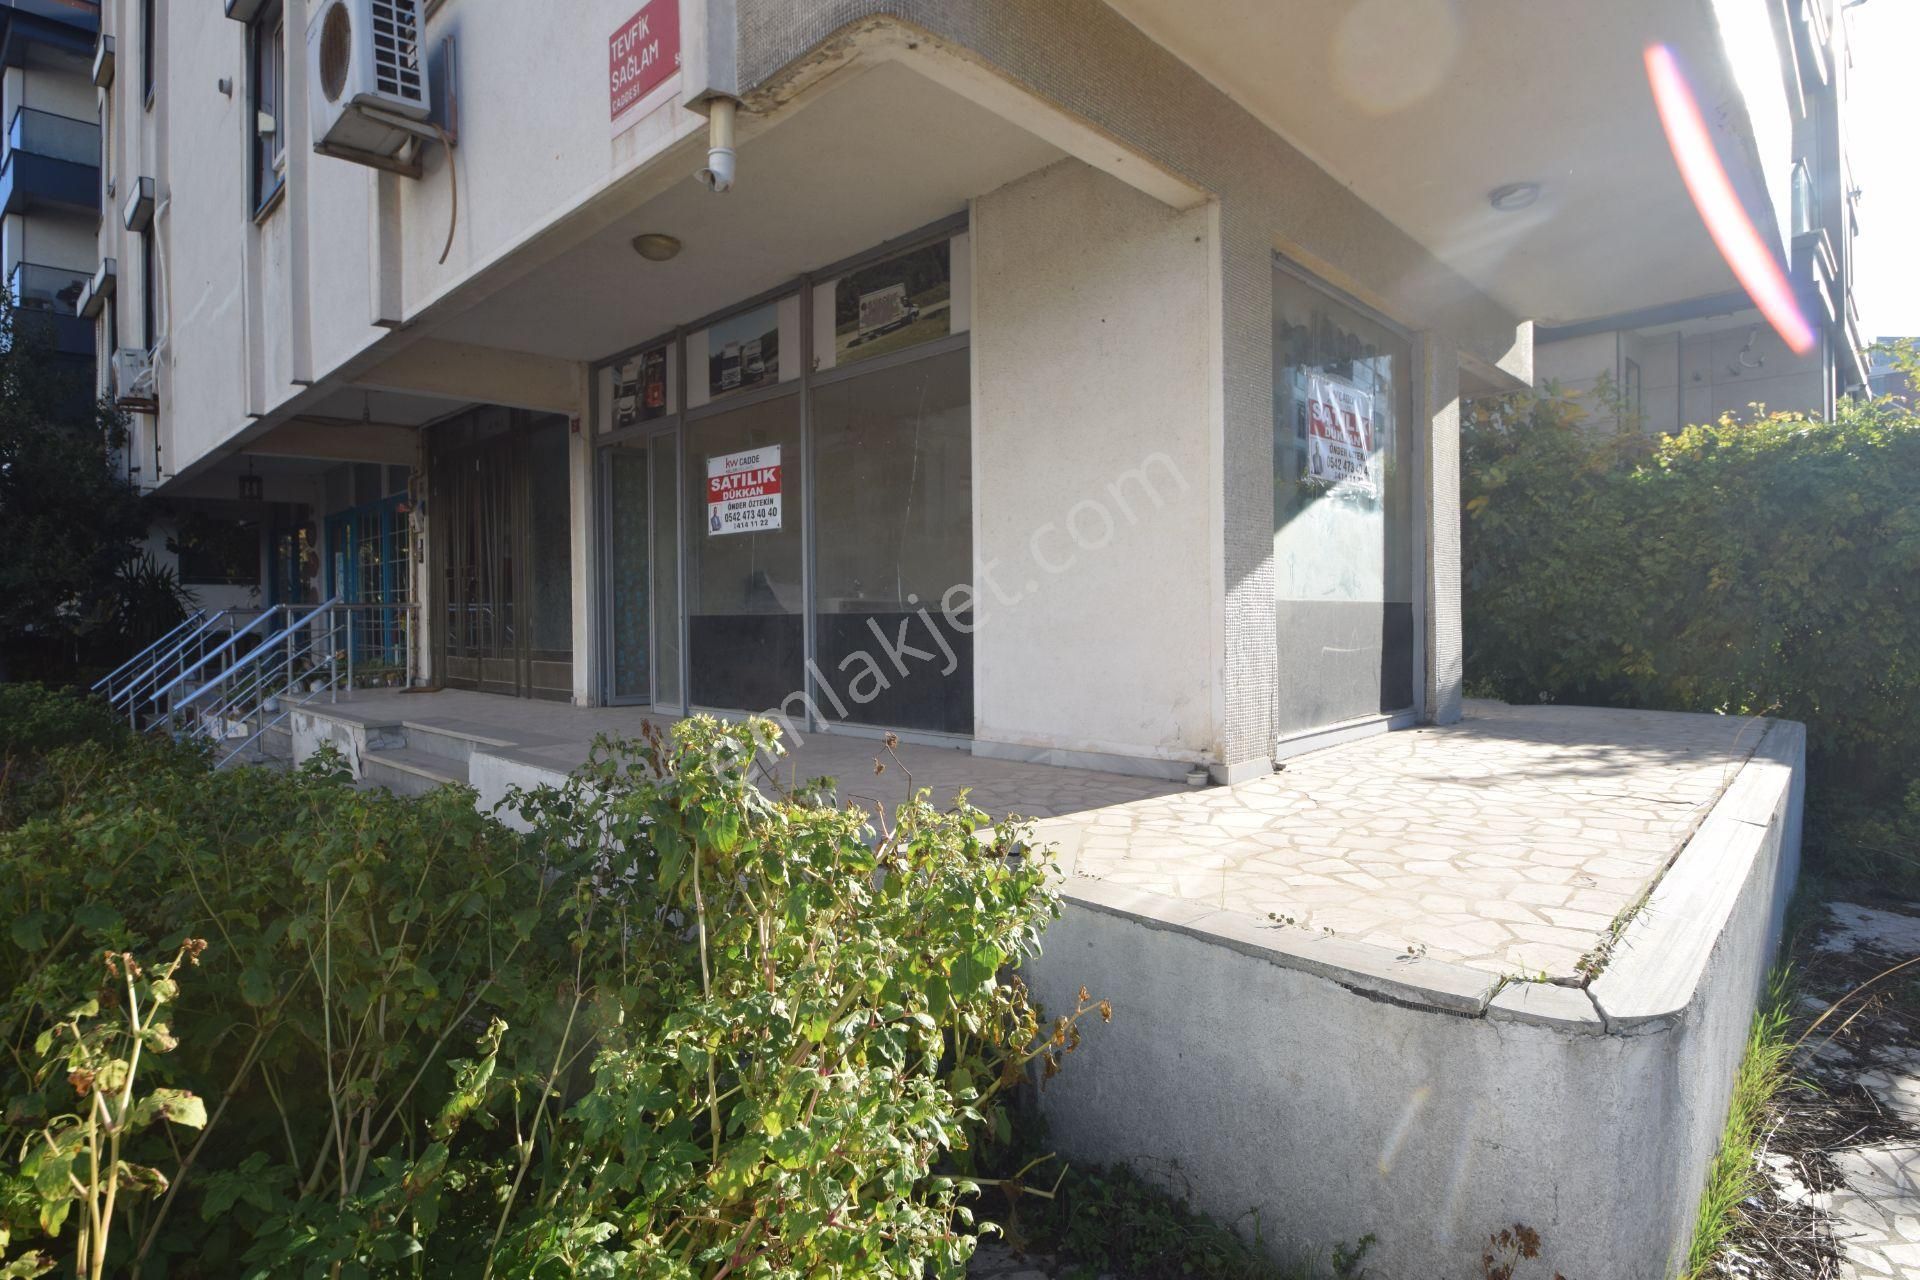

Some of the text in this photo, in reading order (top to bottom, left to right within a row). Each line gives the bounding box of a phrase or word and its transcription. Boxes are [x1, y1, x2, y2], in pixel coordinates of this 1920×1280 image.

[611, 14, 650, 63] TEVFİK
[612, 39, 659, 93] SAĞLAM
[711, 467, 776, 492] SATILIK
[723, 486, 764, 501] DÜKKAN
[724, 506, 778, 523] 0542 473 40 40
[727, 500, 747, 511] ÖNDER
